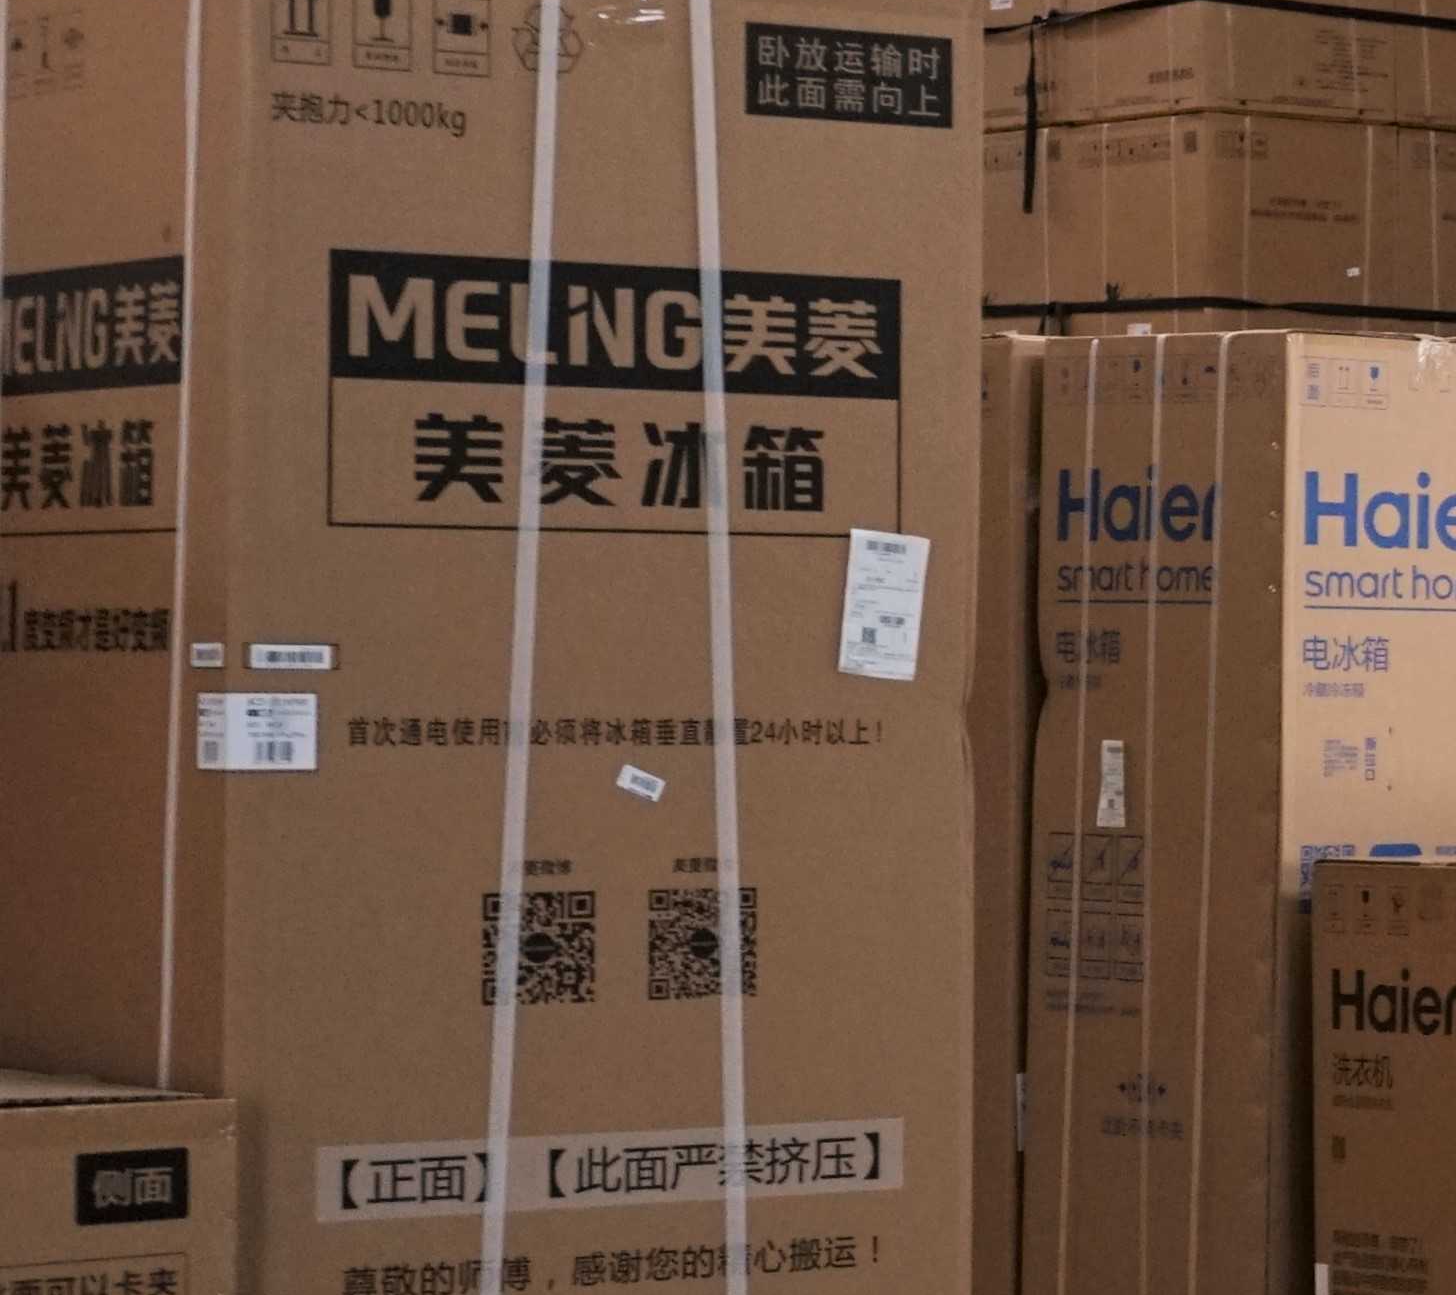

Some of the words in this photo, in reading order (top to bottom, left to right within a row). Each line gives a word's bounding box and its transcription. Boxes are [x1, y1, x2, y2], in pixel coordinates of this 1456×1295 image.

[757, 34, 941, 81] 卧放运输时
[757, 75, 941, 117] 此面需向上
[414, 412, 825, 513] 美菱冰箱
[1056, 468, 1220, 541] Haier
[1304, 569, 1404, 600] smart
[1303, 636, 1390, 673] 电冰箱
[1331, 1053, 1394, 1090] 洗衣机
